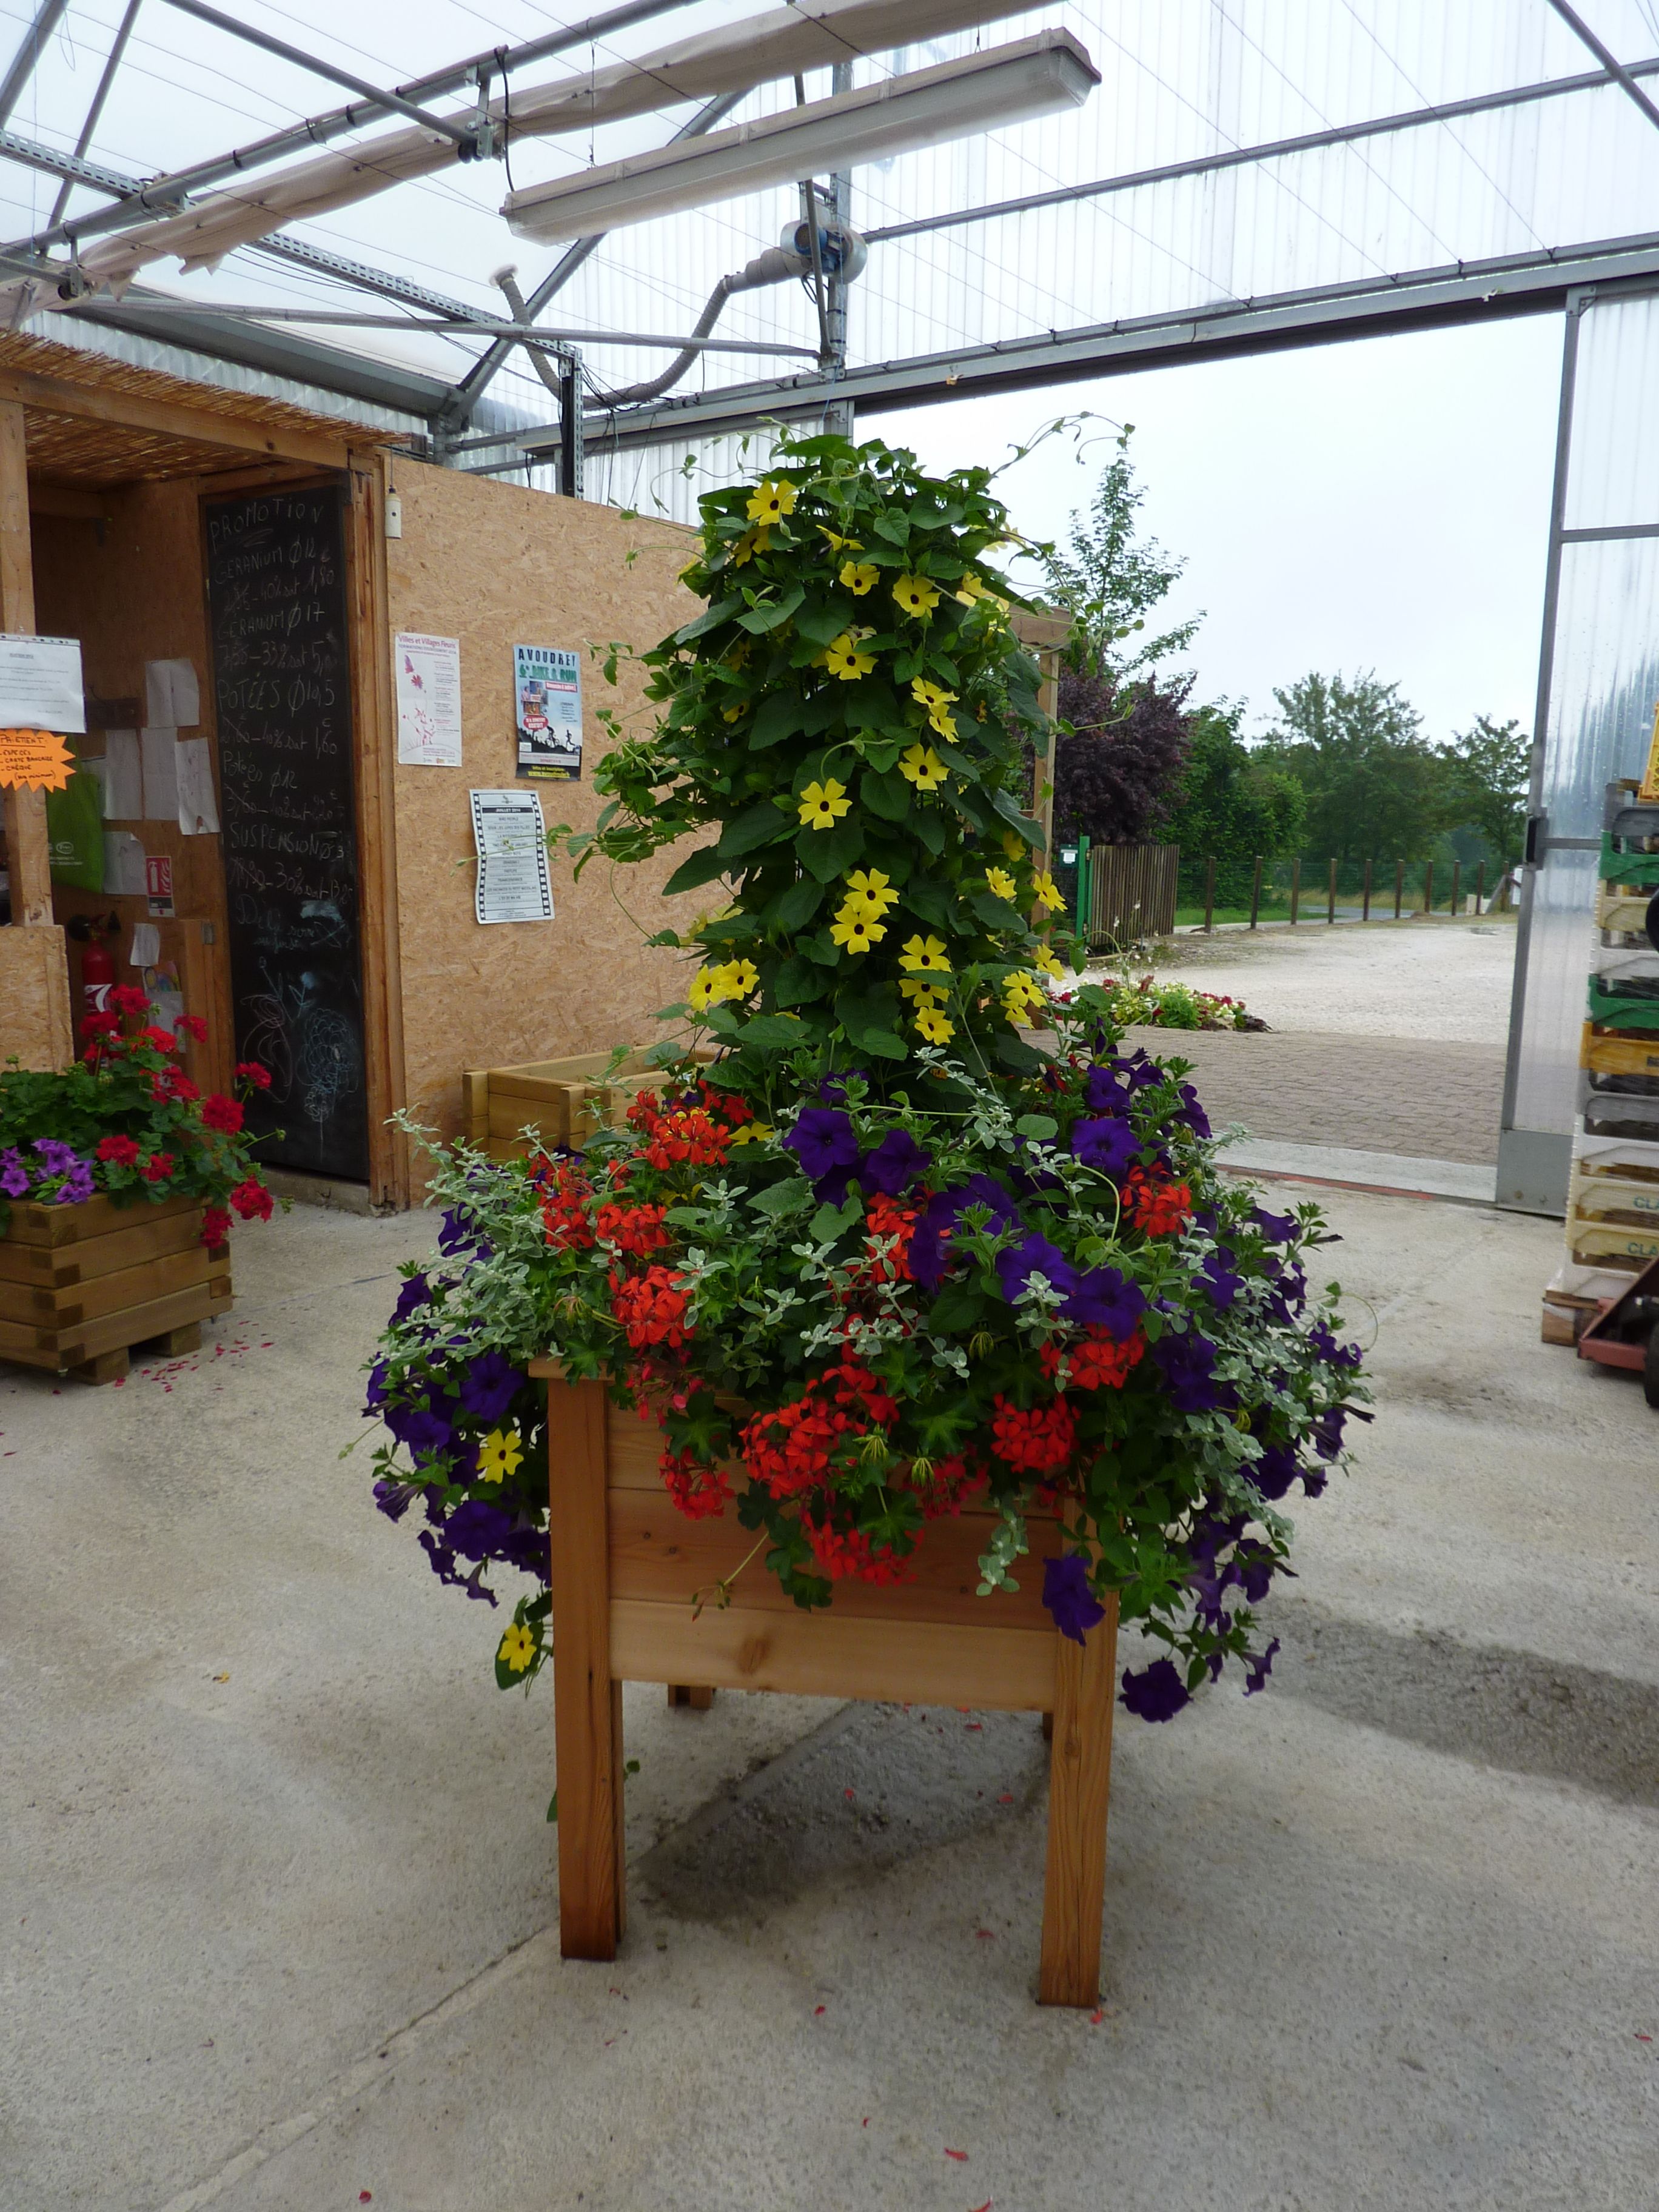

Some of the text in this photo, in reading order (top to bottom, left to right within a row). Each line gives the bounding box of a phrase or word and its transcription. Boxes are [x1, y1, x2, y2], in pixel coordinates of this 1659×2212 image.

[210, 497, 323, 555] PROMOTION
[398, 635, 414, 643] Villes
[421, 638, 440, 647] Villages
[518, 648, 575, 667] AVOUDREY
